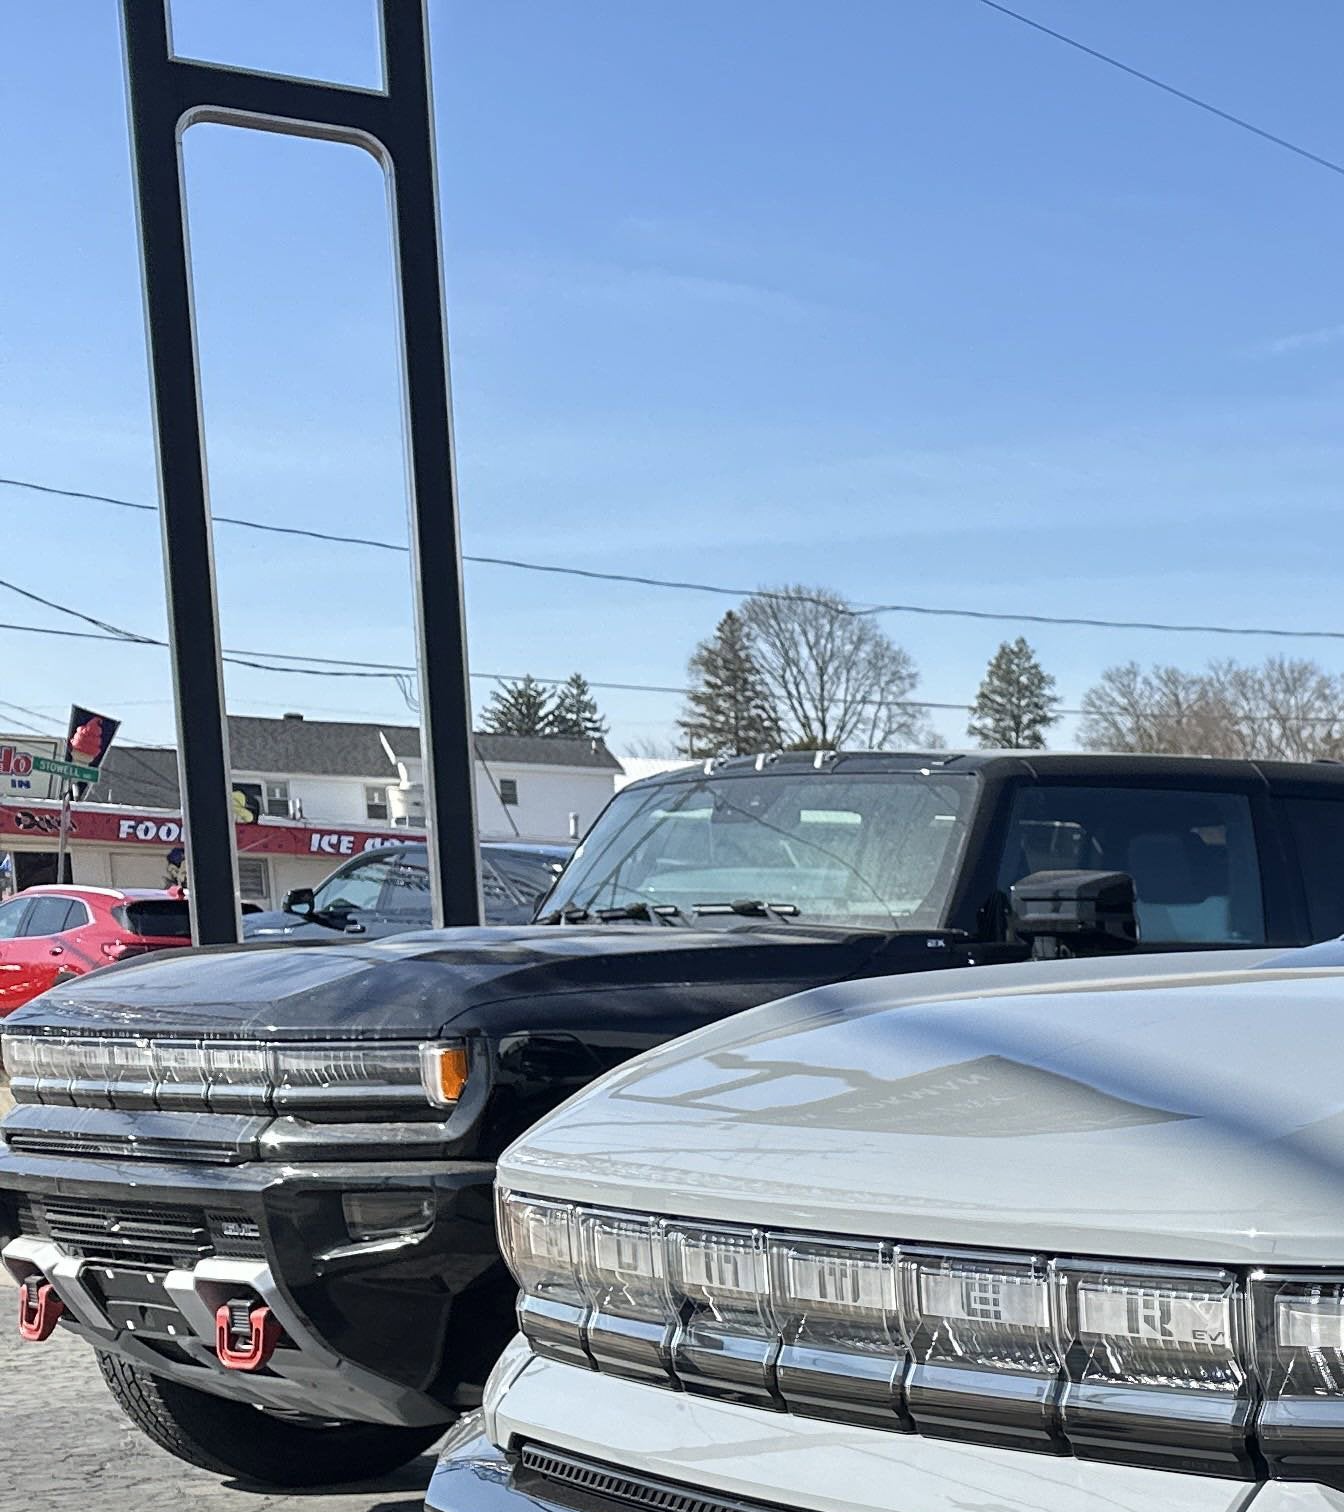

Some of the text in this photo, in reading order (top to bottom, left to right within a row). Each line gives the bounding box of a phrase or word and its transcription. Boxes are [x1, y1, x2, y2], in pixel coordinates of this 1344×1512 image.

[40, 760, 80, 778] STOWELL
[11, 779, 31, 790] IN
[119, 819, 184, 842] FOO
[310, 833, 354, 855] ICE
[222, 1222, 261, 1237] GMC
